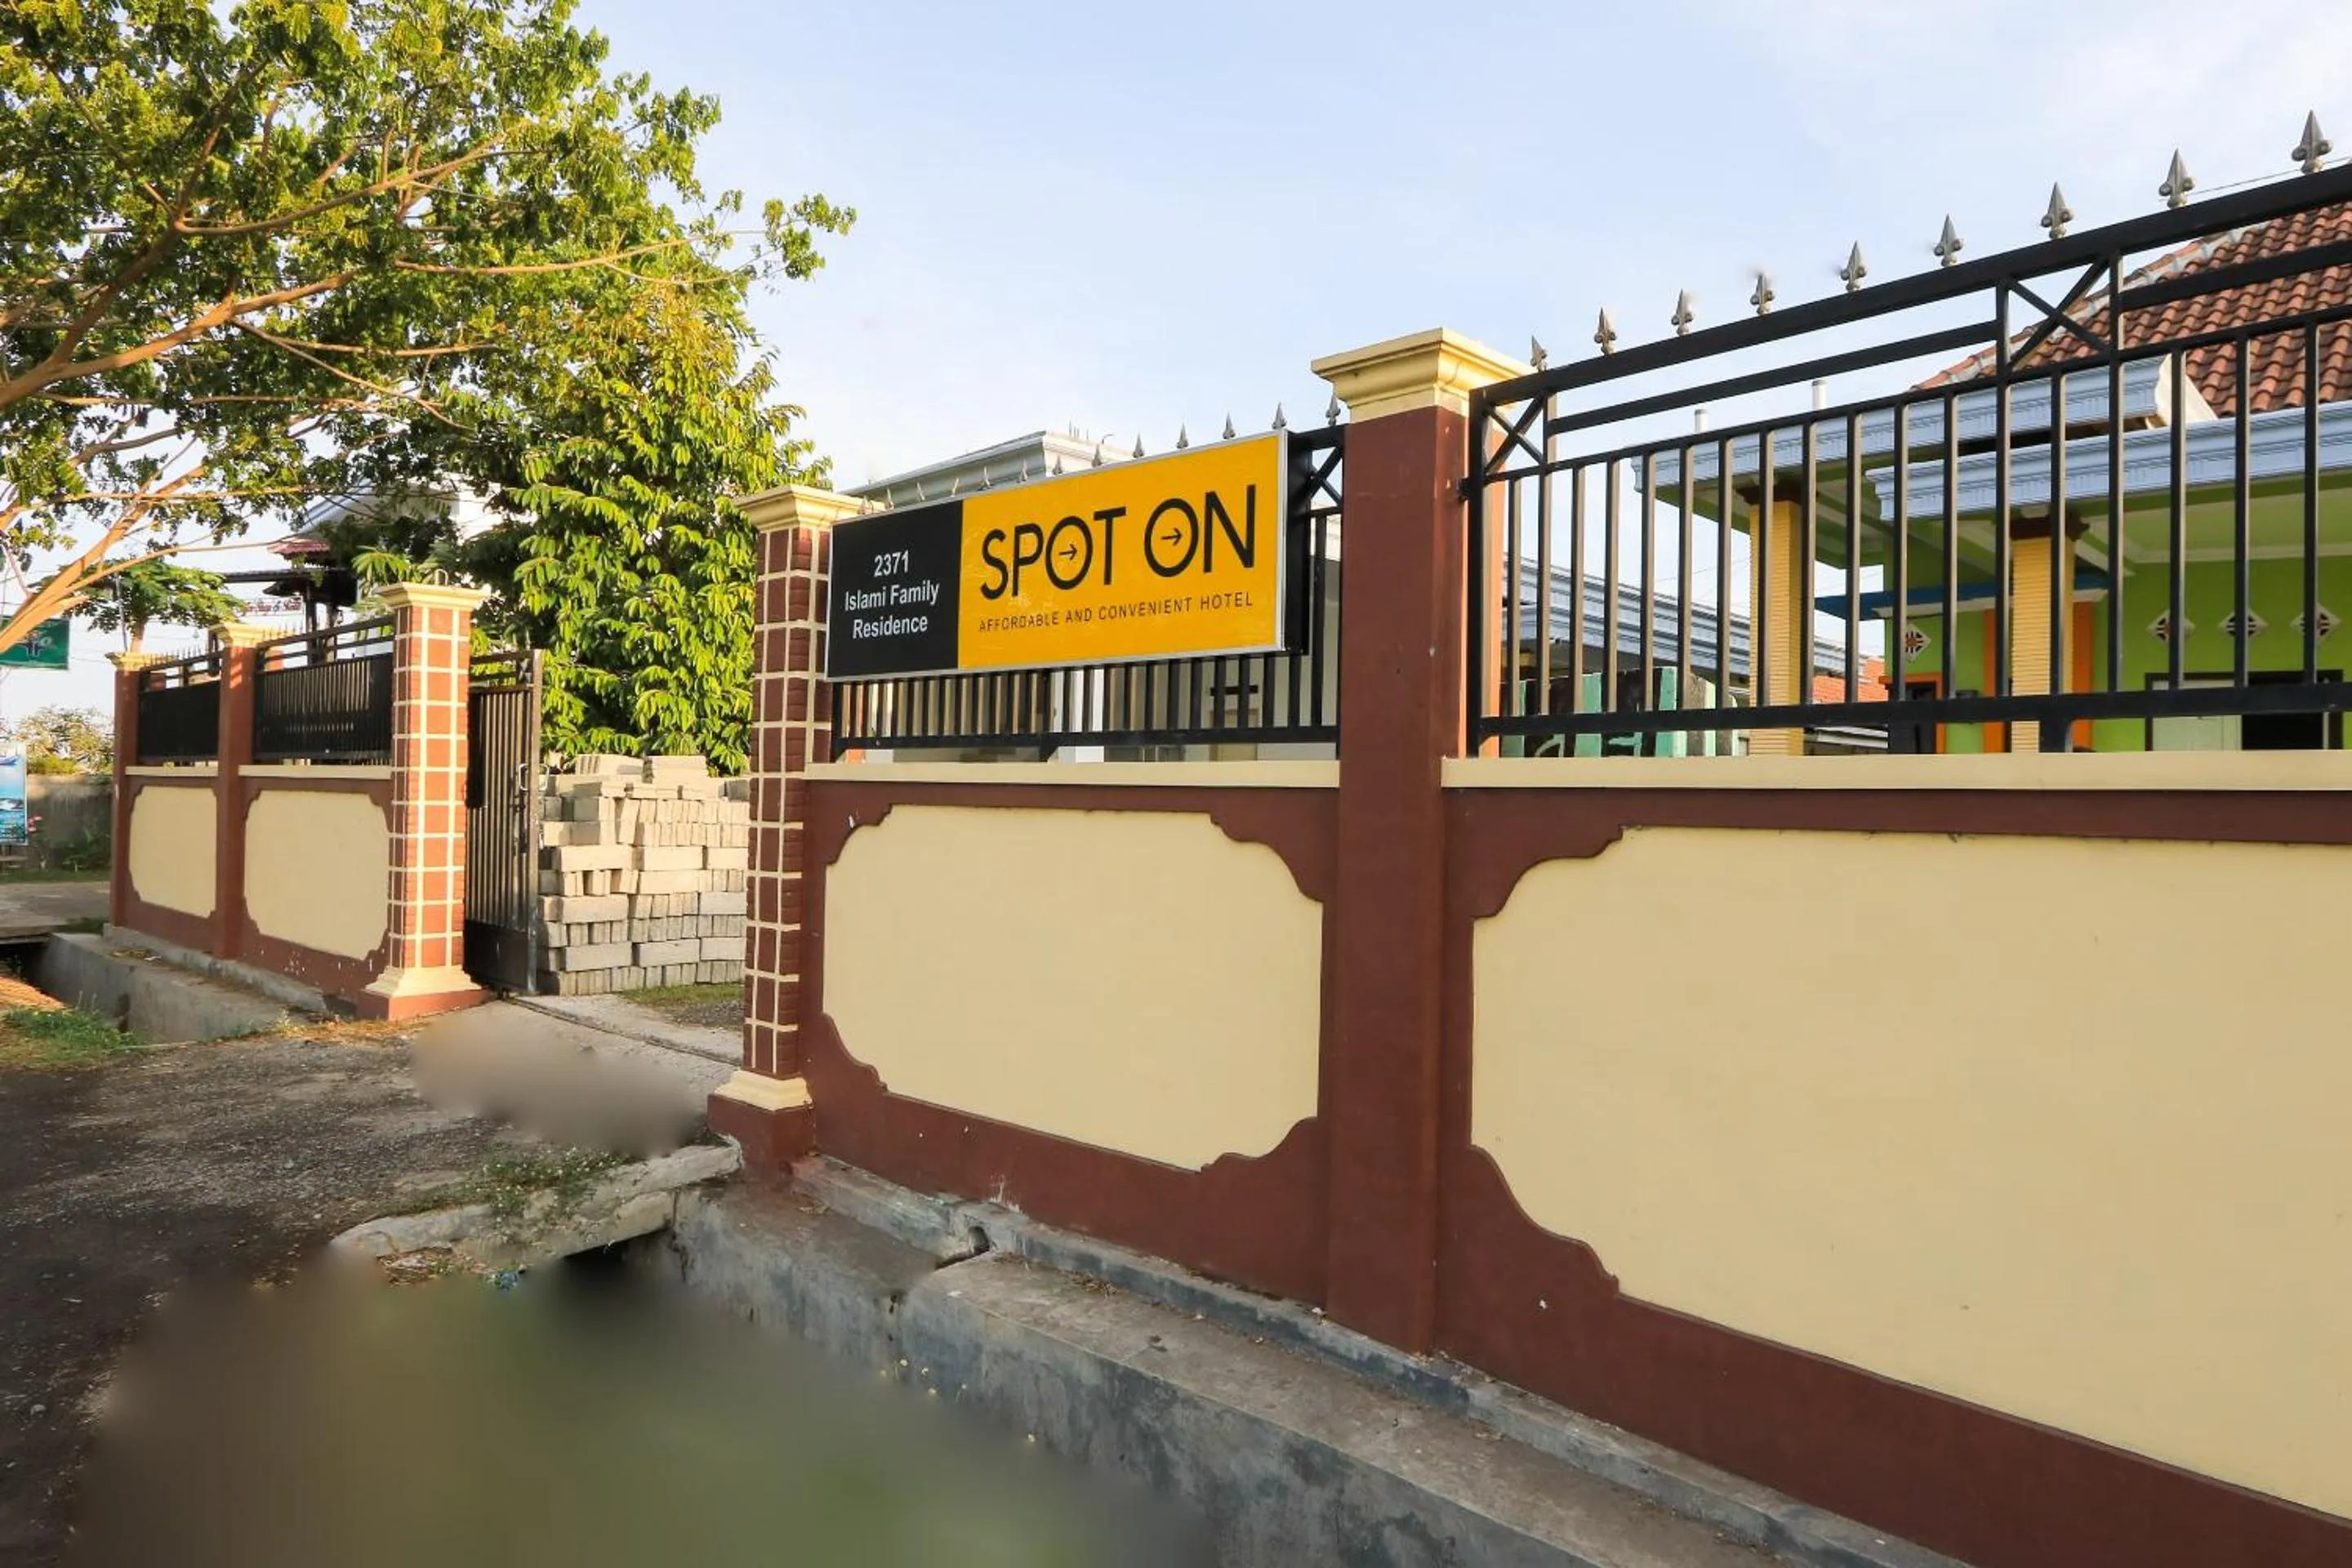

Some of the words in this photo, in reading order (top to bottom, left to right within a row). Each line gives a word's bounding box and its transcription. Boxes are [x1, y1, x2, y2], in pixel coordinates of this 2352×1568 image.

[980, 506, 1127, 600] SPOT
[1144, 484, 1256, 578] ON
[874, 550, 909, 577] 2371
[844, 586, 887, 611] Islami
[890, 579, 939, 606] Family
[853, 615, 928, 639] Residence
[979, 612, 1058, 632] AFFORDABLE
[1066, 608, 1093, 623] AND
[1098, 597, 1192, 620] CONVENIENT
[1200, 591, 1254, 610] HOTEL
